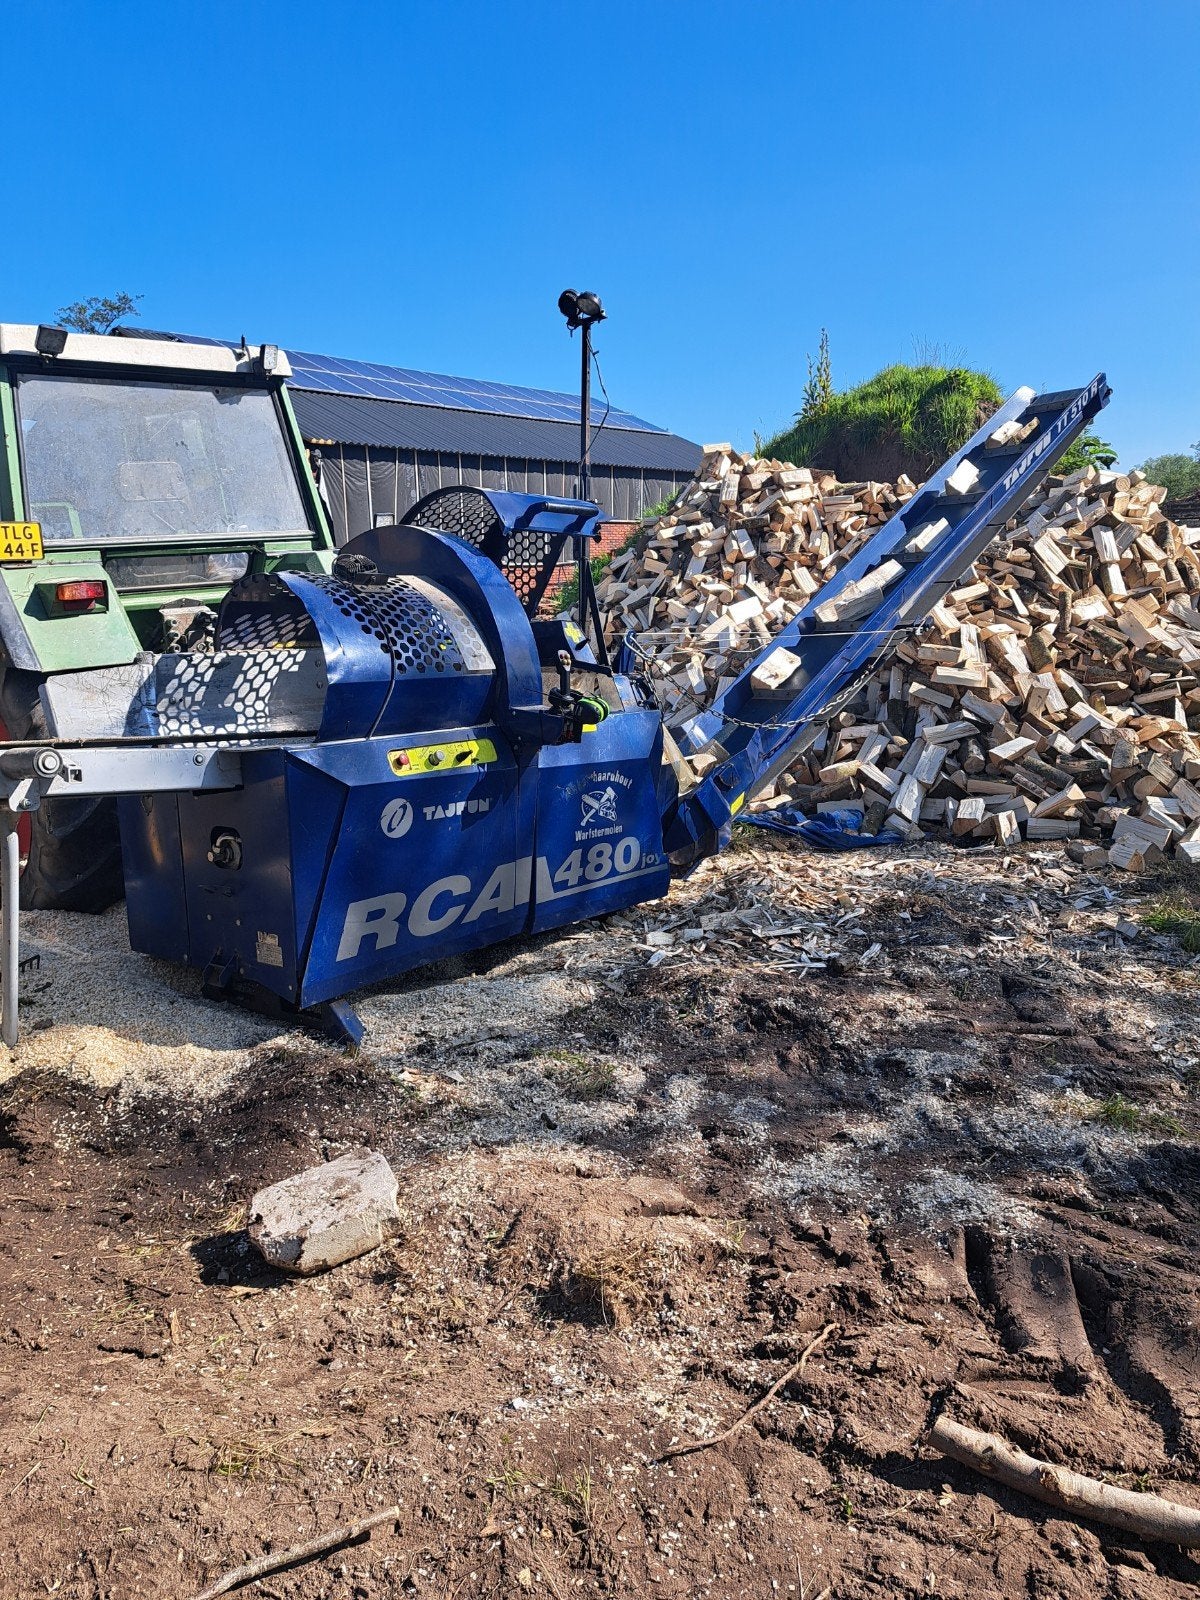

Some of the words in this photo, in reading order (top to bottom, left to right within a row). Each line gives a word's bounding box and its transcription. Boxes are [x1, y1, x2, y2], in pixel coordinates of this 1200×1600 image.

[1003, 430, 1052, 491] TAJFUN
[1071, 394, 1089, 420] 510
[1090, 380, 1098, 398] R
[0, 525, 33, 540] TLG
[3, 542, 39, 557] 44-F
[422, 798, 490, 821] TAJFUN
[574, 823, 623, 842] Warfstermolen
[553, 836, 641, 887] 480
[640, 852, 660, 869] joy
